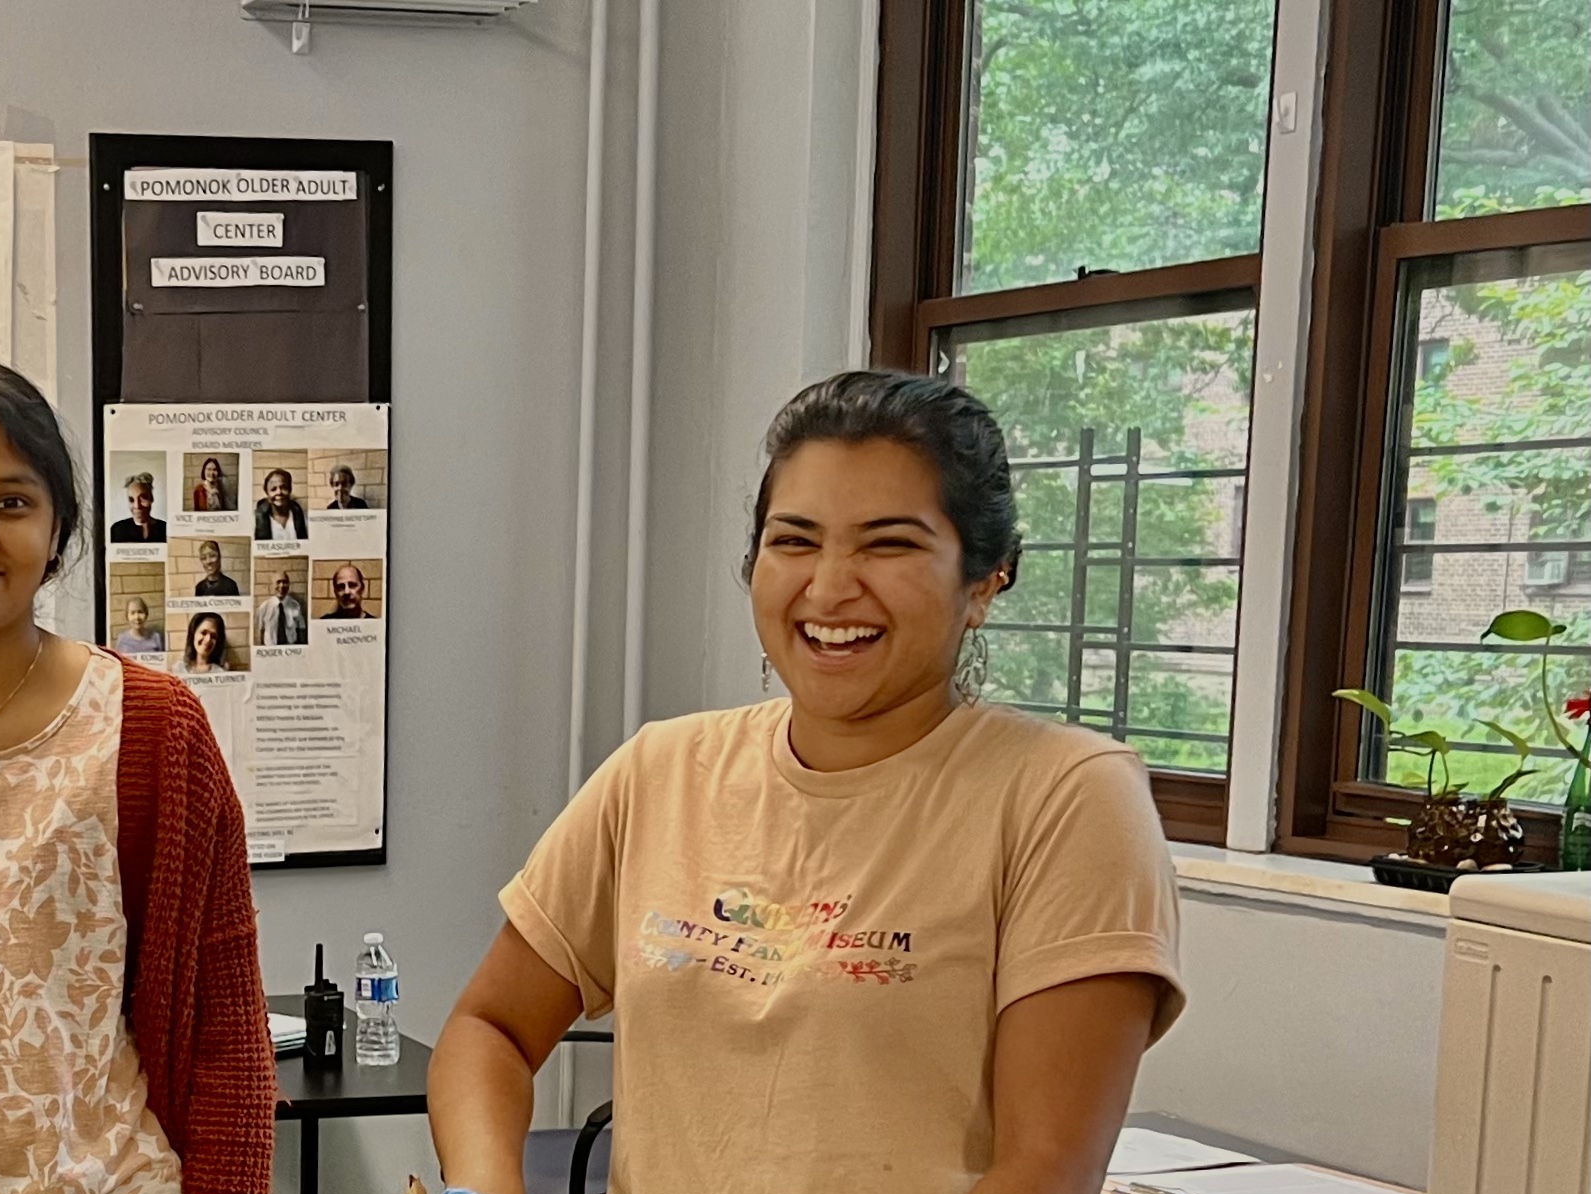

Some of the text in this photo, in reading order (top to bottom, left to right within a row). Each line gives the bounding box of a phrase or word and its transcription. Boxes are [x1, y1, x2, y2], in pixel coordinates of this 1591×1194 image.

[140, 177, 349, 196] POMONOK OLDER ADULT
[212, 223, 276, 239] CENTER
[167, 265, 317, 281] ADVISORY BOARD
[148, 410, 346, 425] POMONOK OLDER ADULT CENTER
